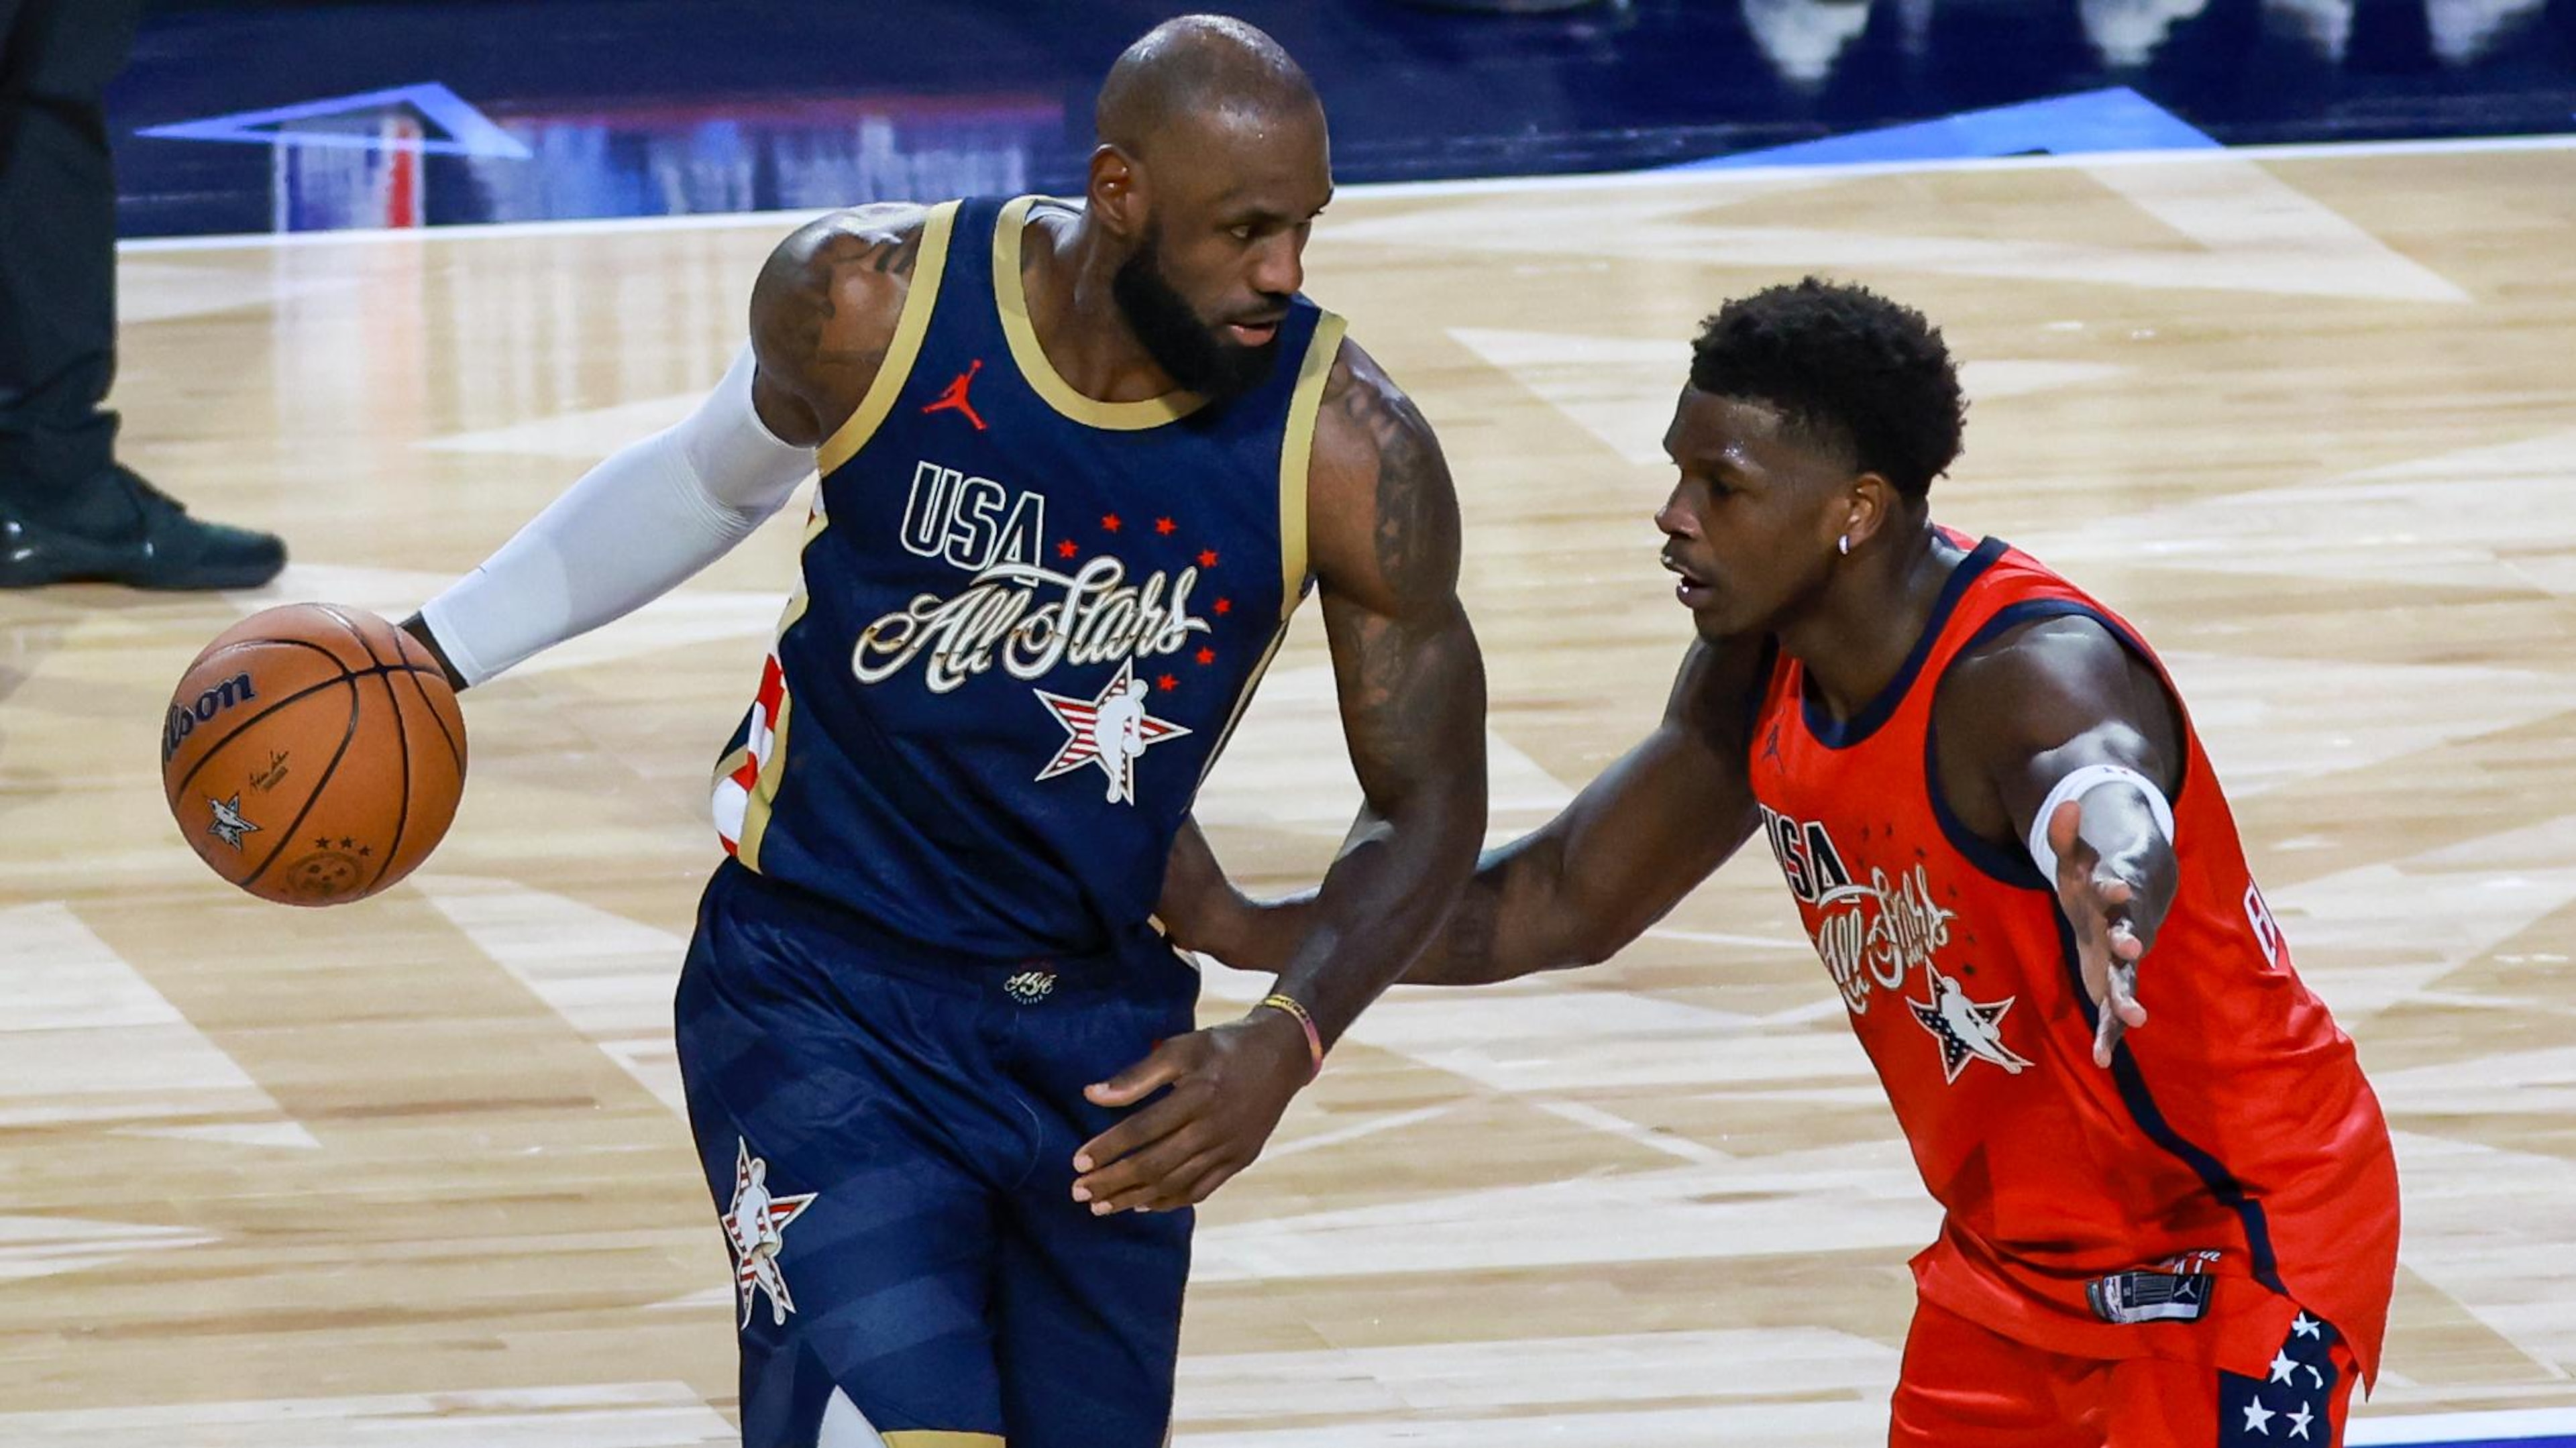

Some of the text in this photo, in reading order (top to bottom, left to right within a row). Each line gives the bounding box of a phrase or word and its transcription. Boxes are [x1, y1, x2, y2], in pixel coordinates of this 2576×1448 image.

[900, 460, 1046, 588] USA
[851, 555, 1212, 693] All Stars
[165, 673, 256, 763] lson
[1758, 803, 1860, 904] USA
